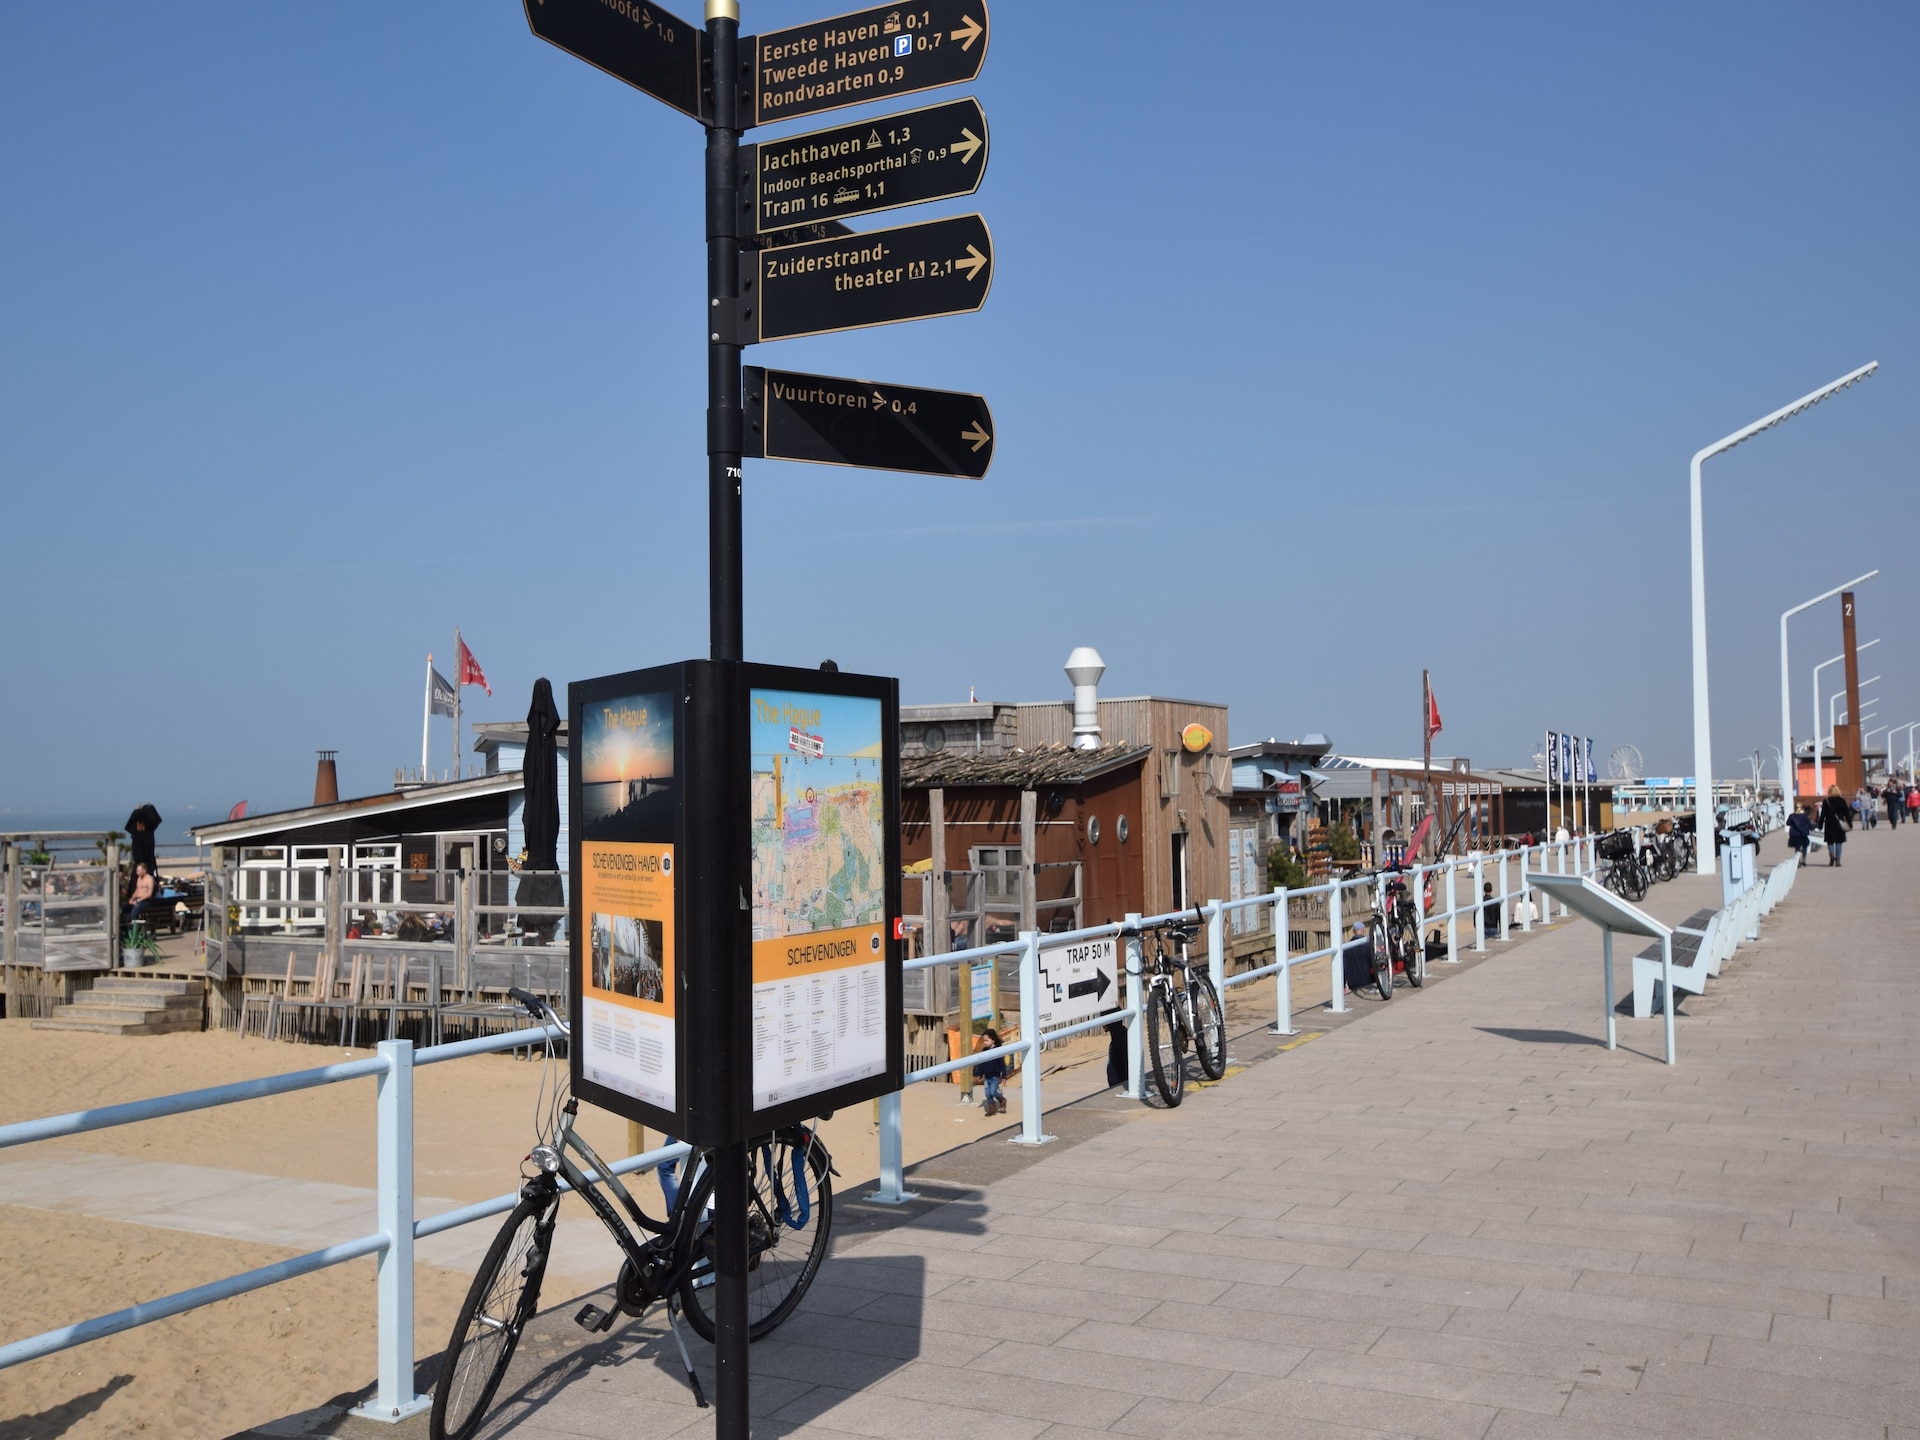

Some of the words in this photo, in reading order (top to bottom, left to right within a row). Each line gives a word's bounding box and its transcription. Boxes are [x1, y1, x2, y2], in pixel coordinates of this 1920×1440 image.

[601, 0, 640, 23] oofd
[657, 22, 675, 43] 1,0
[763, 38, 818, 62] Eerste
[824, 23, 879, 49] Haven
[906, 11, 929, 29] 0,1
[763, 57, 829, 85] Tweede
[835, 45, 890, 70] Haven
[917, 32, 942, 51] 0,7
[763, 72, 874, 109] Rondvaarten
[878, 66, 904, 84] 0,9
[763, 138, 861, 172] Jachthaven
[888, 127, 911, 146] 1,3
[763, 176, 806, 195] Indoor
[810, 152, 907, 185] Beachsporthal
[927, 148, 947, 161] 0,9
[763, 197, 806, 218] Tram
[811, 193, 829, 209] 16
[865, 181, 884, 199] 1,1
[767, 243, 890, 279] Zuiderstrand-
[834, 267, 903, 291] theater
[930, 260, 952, 277] 2,1
[773, 382, 867, 409] Vuurtoren
[892, 399, 918, 415] 0,4
[1845, 603, 1852, 616] 2
[603, 708, 618, 729] The
[620, 706, 647, 732] Hague
[754, 699, 779, 724] The
[782, 702, 822, 731] Hague
[592, 853, 637, 871] SCHEVENINGEN
[637, 855, 660, 872] HAVEN
[787, 939, 857, 966] SCHEVENINGEN
[1067, 946, 1089, 964] TRAP
[1092, 944, 1102, 959] 50
[1104, 942, 1111, 957] M
[588, 1184, 630, 1238] Gazelle
